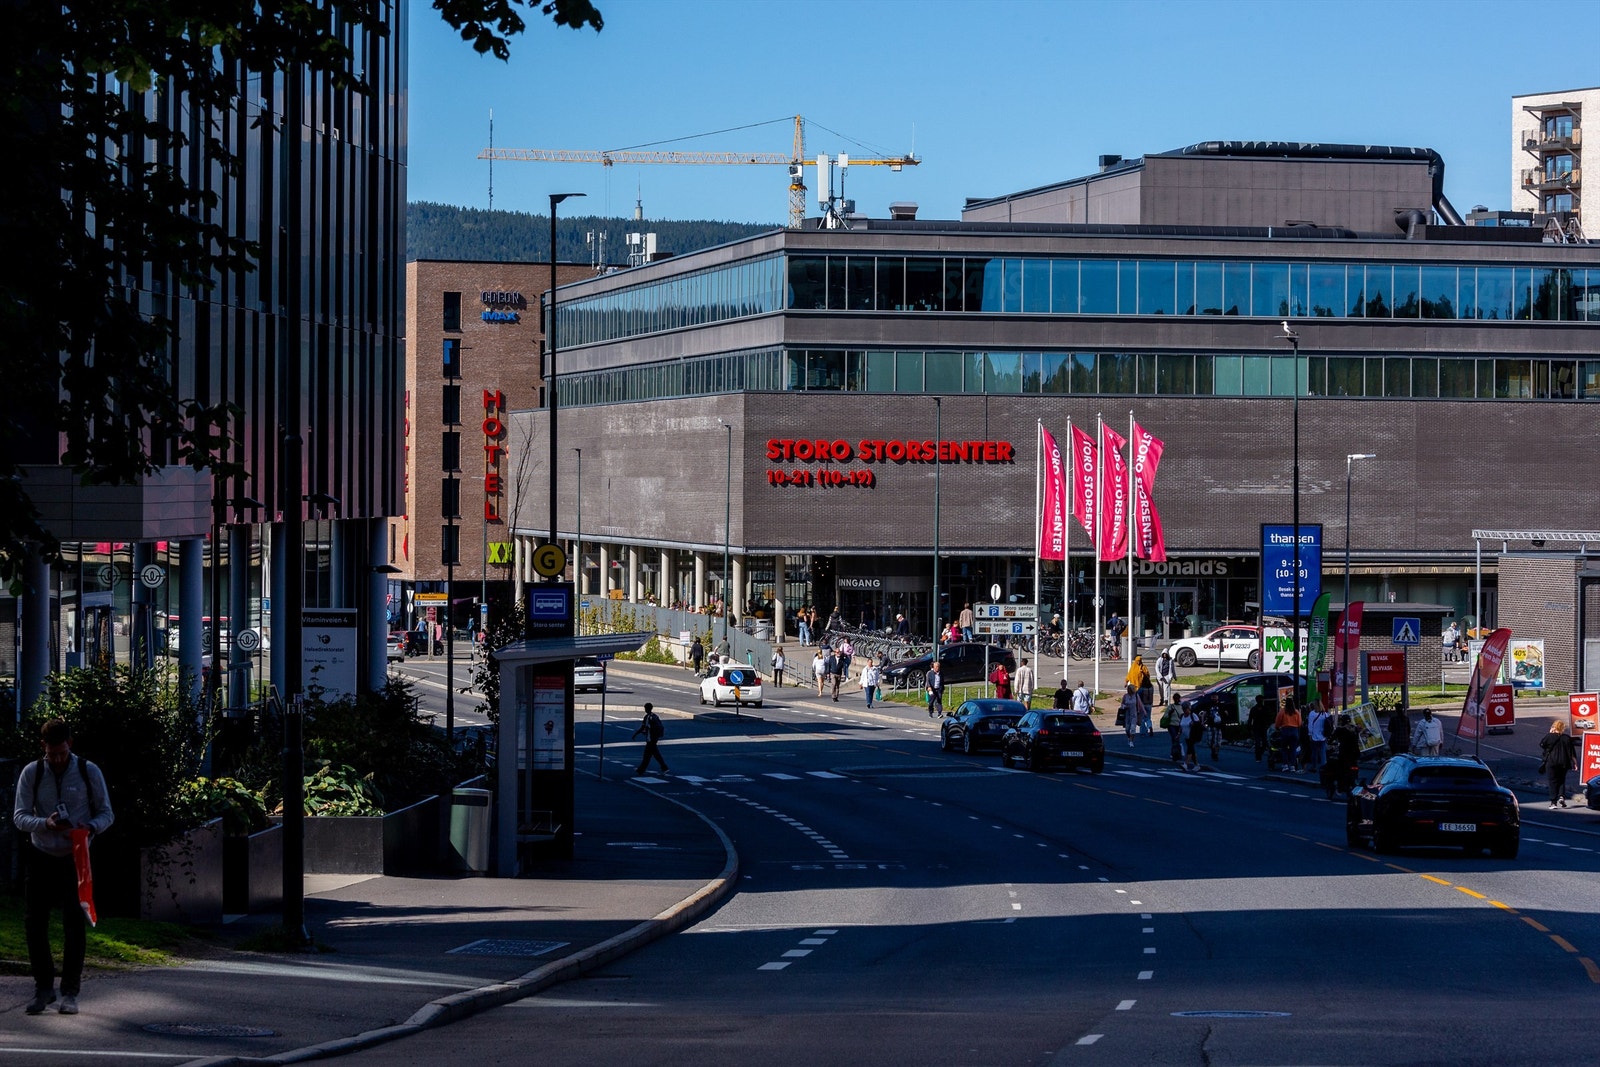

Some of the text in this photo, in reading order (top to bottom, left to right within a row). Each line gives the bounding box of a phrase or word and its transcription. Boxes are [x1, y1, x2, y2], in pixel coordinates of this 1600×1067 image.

[481, 290, 519, 304] ODEON
[481, 311, 517, 321] IMAX
[483, 390, 502, 520] HOTEL
[765, 439, 1014, 462] STORO STORSENTER
[1134, 431, 1154, 473] STORO
[766, 468, 873, 486] 10-21 (10-19)
[1083, 474, 1094, 540] STORSENT
[540, 551, 556, 570] G
[1108, 559, 1228, 575] McDonald's
[838, 578, 881, 588] INNGANG
[1265, 635, 1300, 652] KIW
